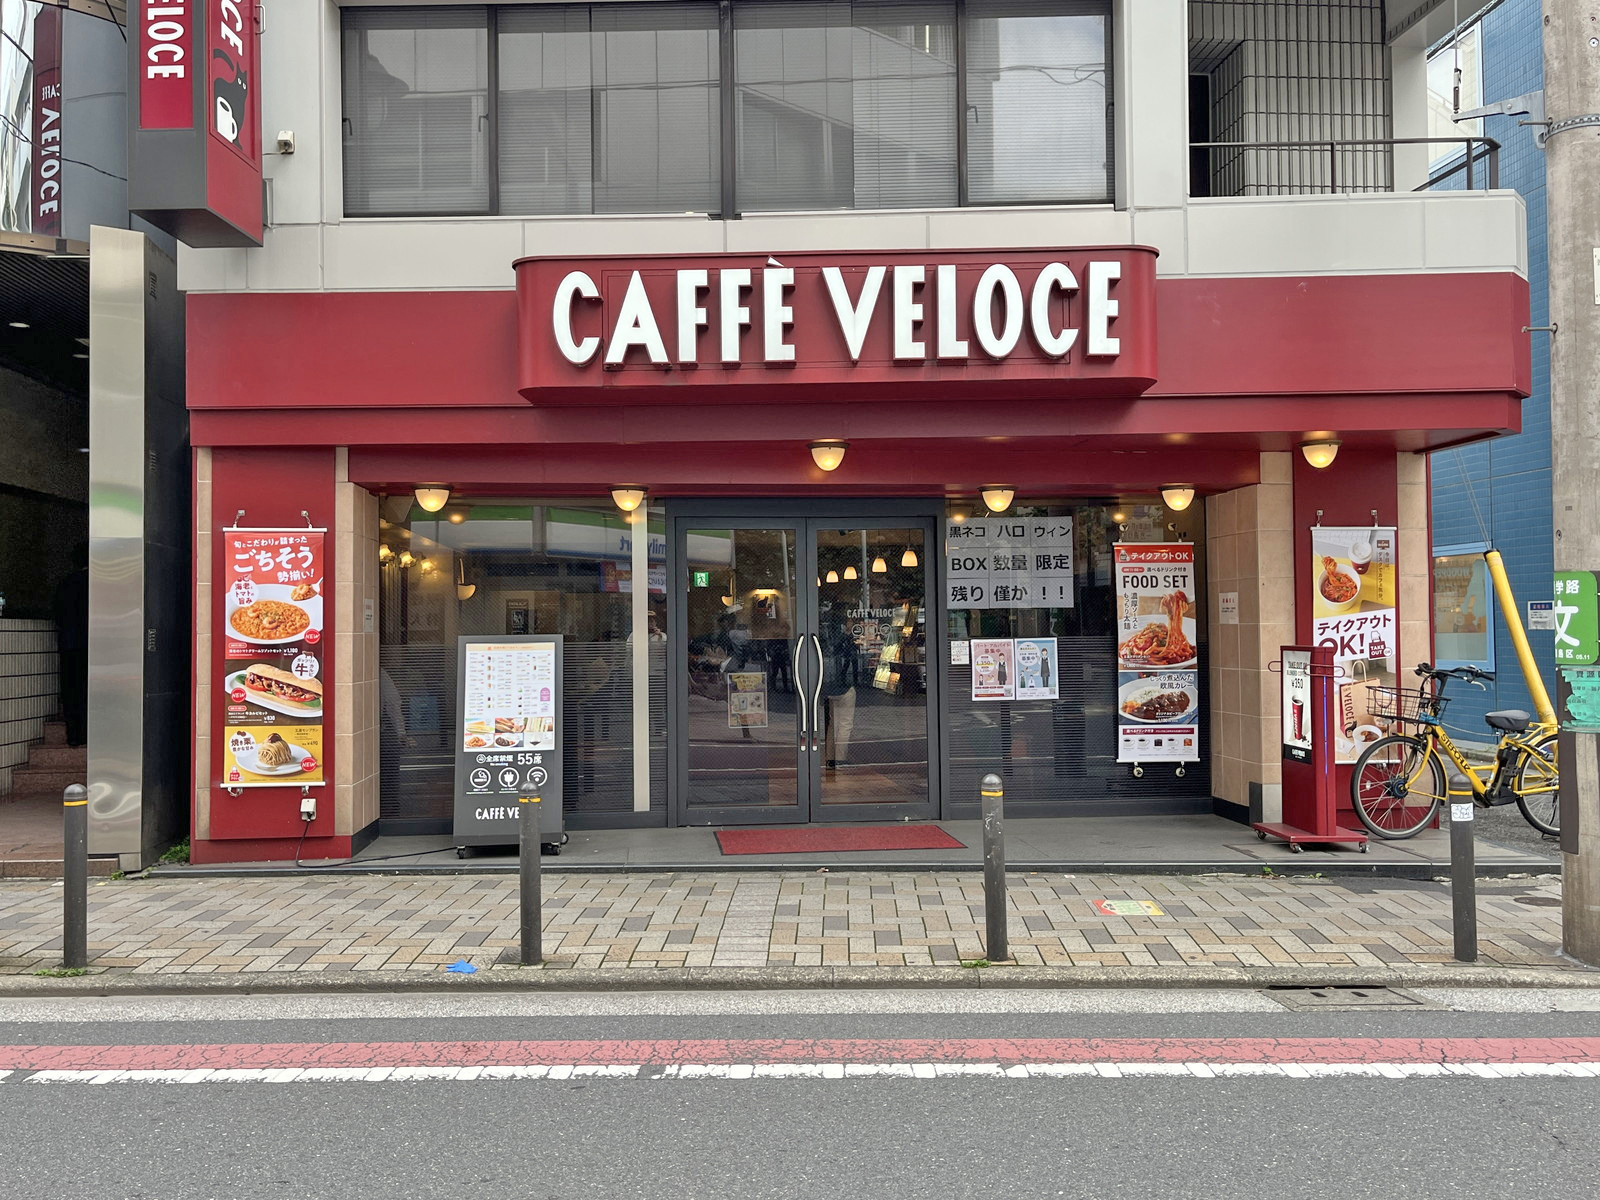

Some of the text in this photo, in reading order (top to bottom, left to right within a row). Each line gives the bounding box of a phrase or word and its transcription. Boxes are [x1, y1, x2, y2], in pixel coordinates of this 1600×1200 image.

[147, 0, 185, 79] LOCE
[553, 256, 1121, 364] CAFFÈ VELOCE
[949, 525, 1070, 538] 黒ネコ ハロ ウィン
[233, 546, 314, 573] ごちそう
[951, 554, 1070, 571] BOX 数量 限定
[1131, 552, 1189, 560] テイクアウトOK
[1122, 575, 1188, 589] FOOD SET
[951, 585, 984, 602] 残り
[994, 585, 1028, 602] 僅か
[1317, 614, 1392, 636] テイクアウト
[295, 663, 308, 676] 牛
[1344, 692, 1355, 720] VELOCE
